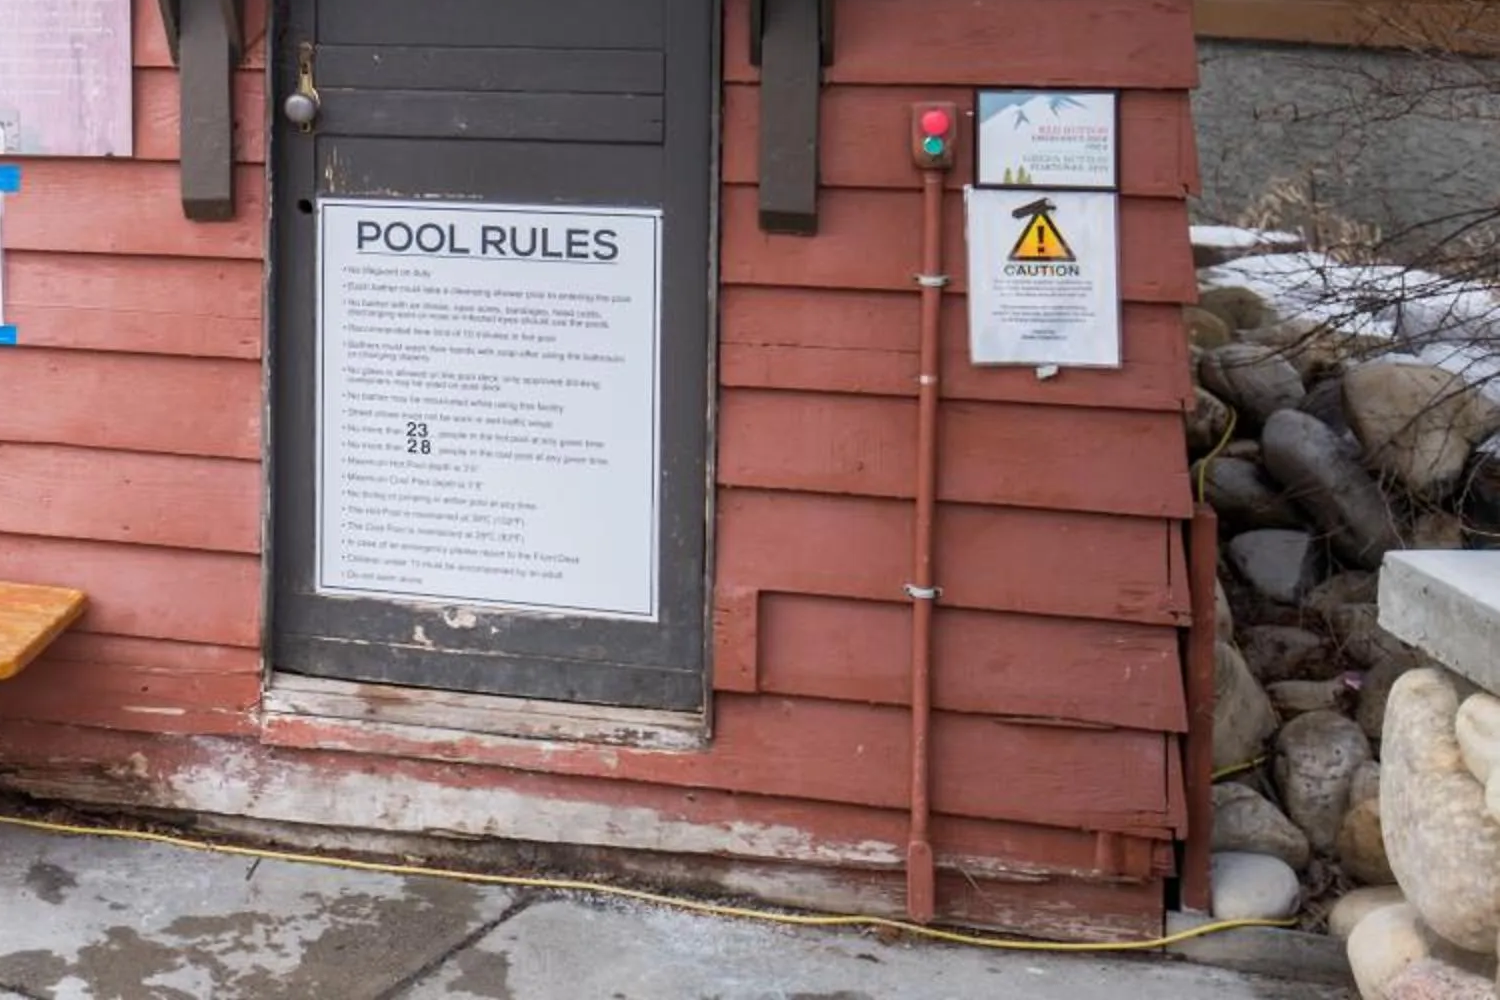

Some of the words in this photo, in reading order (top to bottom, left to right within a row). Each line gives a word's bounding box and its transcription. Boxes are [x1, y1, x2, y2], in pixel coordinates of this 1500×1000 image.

[357, 220, 470, 255] POOL
[481, 225, 619, 261] RULES
[1003, 264, 1080, 277] CAUTION
[406, 421, 429, 438] 23
[407, 439, 431, 455] 28
